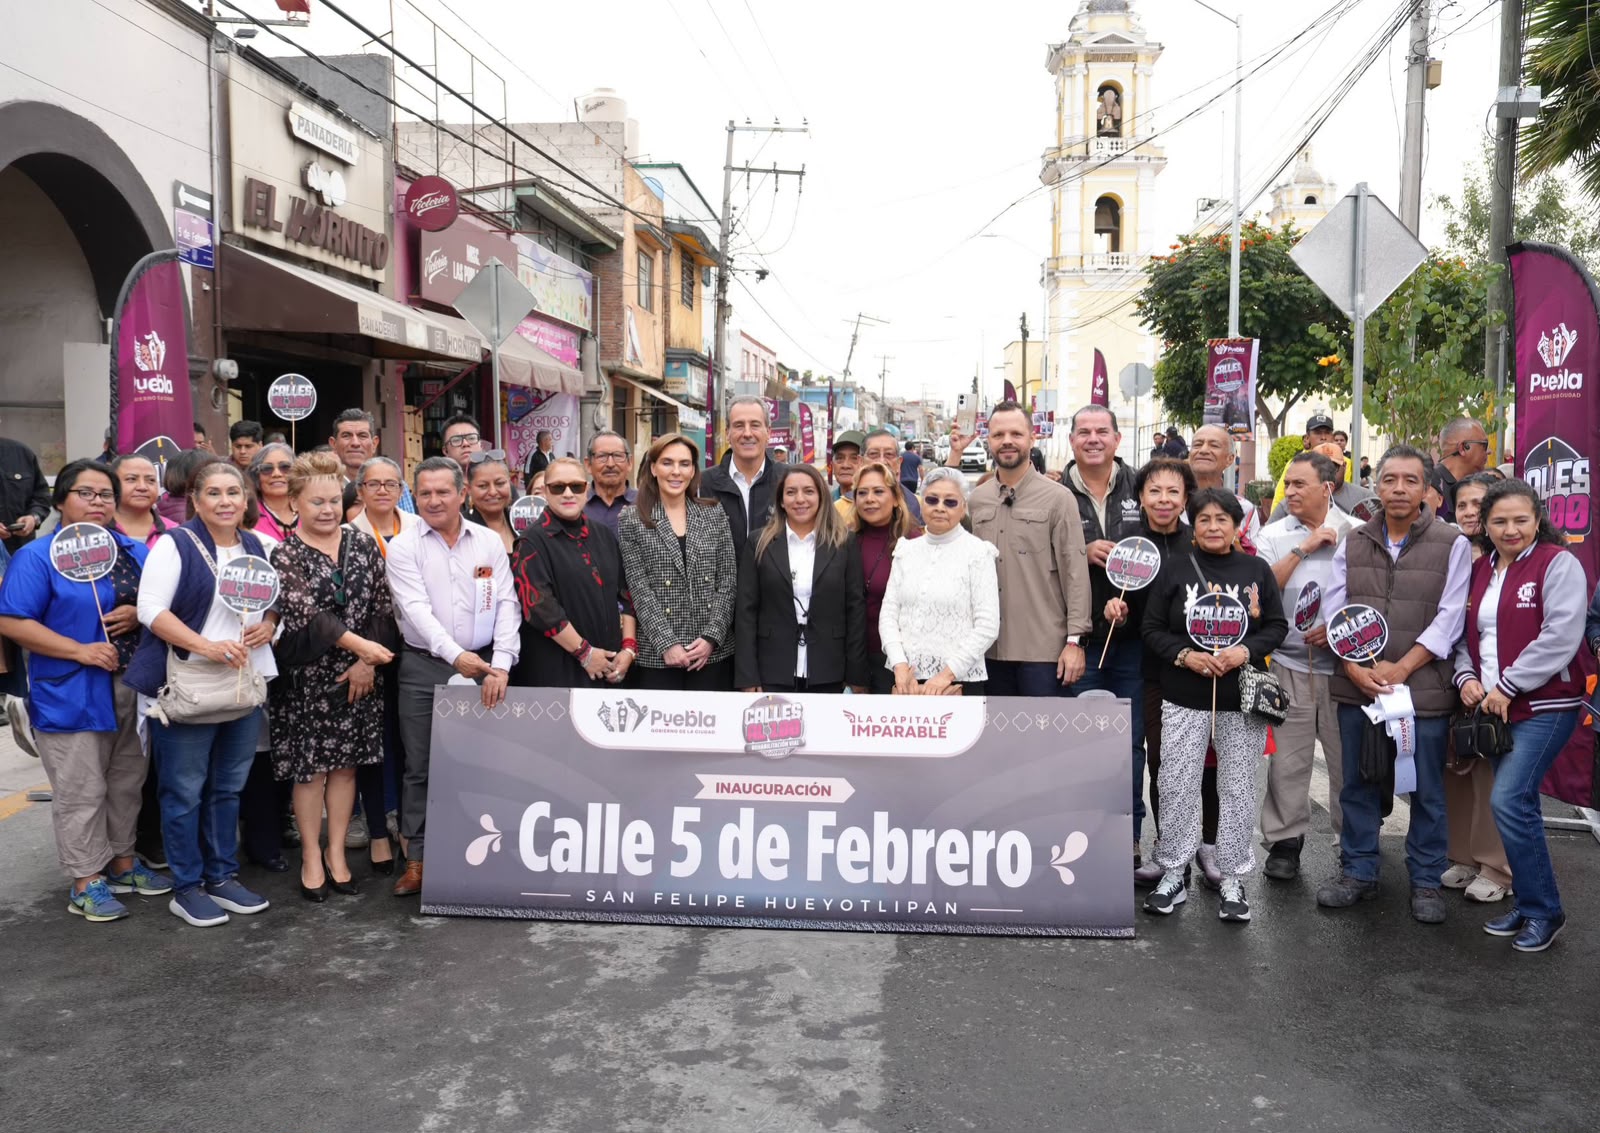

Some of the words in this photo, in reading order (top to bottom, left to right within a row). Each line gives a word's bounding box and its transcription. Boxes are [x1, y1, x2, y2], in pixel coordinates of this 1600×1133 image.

[297, 116, 353, 157] PANADERIA
[244, 177, 282, 232] EL
[410, 190, 450, 217] Victoria
[178, 226, 183, 237] 5
[183, 229, 191, 240] de
[424, 247, 449, 285] Victoria
[360, 316, 398, 339] PANADERIA
[447, 335, 480, 359] HORNITO
[134, 374, 173, 394] uebla
[272, 384, 313, 396] CALLES
[1530, 370, 1582, 393] Puebla
[1525, 458, 1591, 499] ALLES
[53, 532, 109, 556] CALLES
[1112, 546, 1159, 565] CALLES
[222, 566, 276, 585] CALLES
[1190, 606, 1244, 620] CALLES
[1190, 619, 1209, 635] AL
[1210, 620, 1241, 636] 100
[1329, 609, 1377, 643] CALLES
[1336, 637, 1357, 656] AL
[651, 709, 716, 727] Puebla
[744, 703, 803, 725] CALLES
[857, 715, 873, 723] LA
[880, 715, 938, 724] CAPITAL
[747, 723, 768, 743] AL
[769, 719, 802, 740] 100
[851, 725, 947, 738] IMPARABLE
[715, 780, 832, 797] INAUGURACIÓN
[519, 801, 655, 876] Calle
[670, 806, 702, 878] 5
[718, 808, 790, 881] de
[807, 810, 1033, 888] Febrero
[585, 890, 635, 904] SAN
[654, 893, 745, 908] FELIPE
[765, 896, 959, 915] HUEYOTLIPAN
